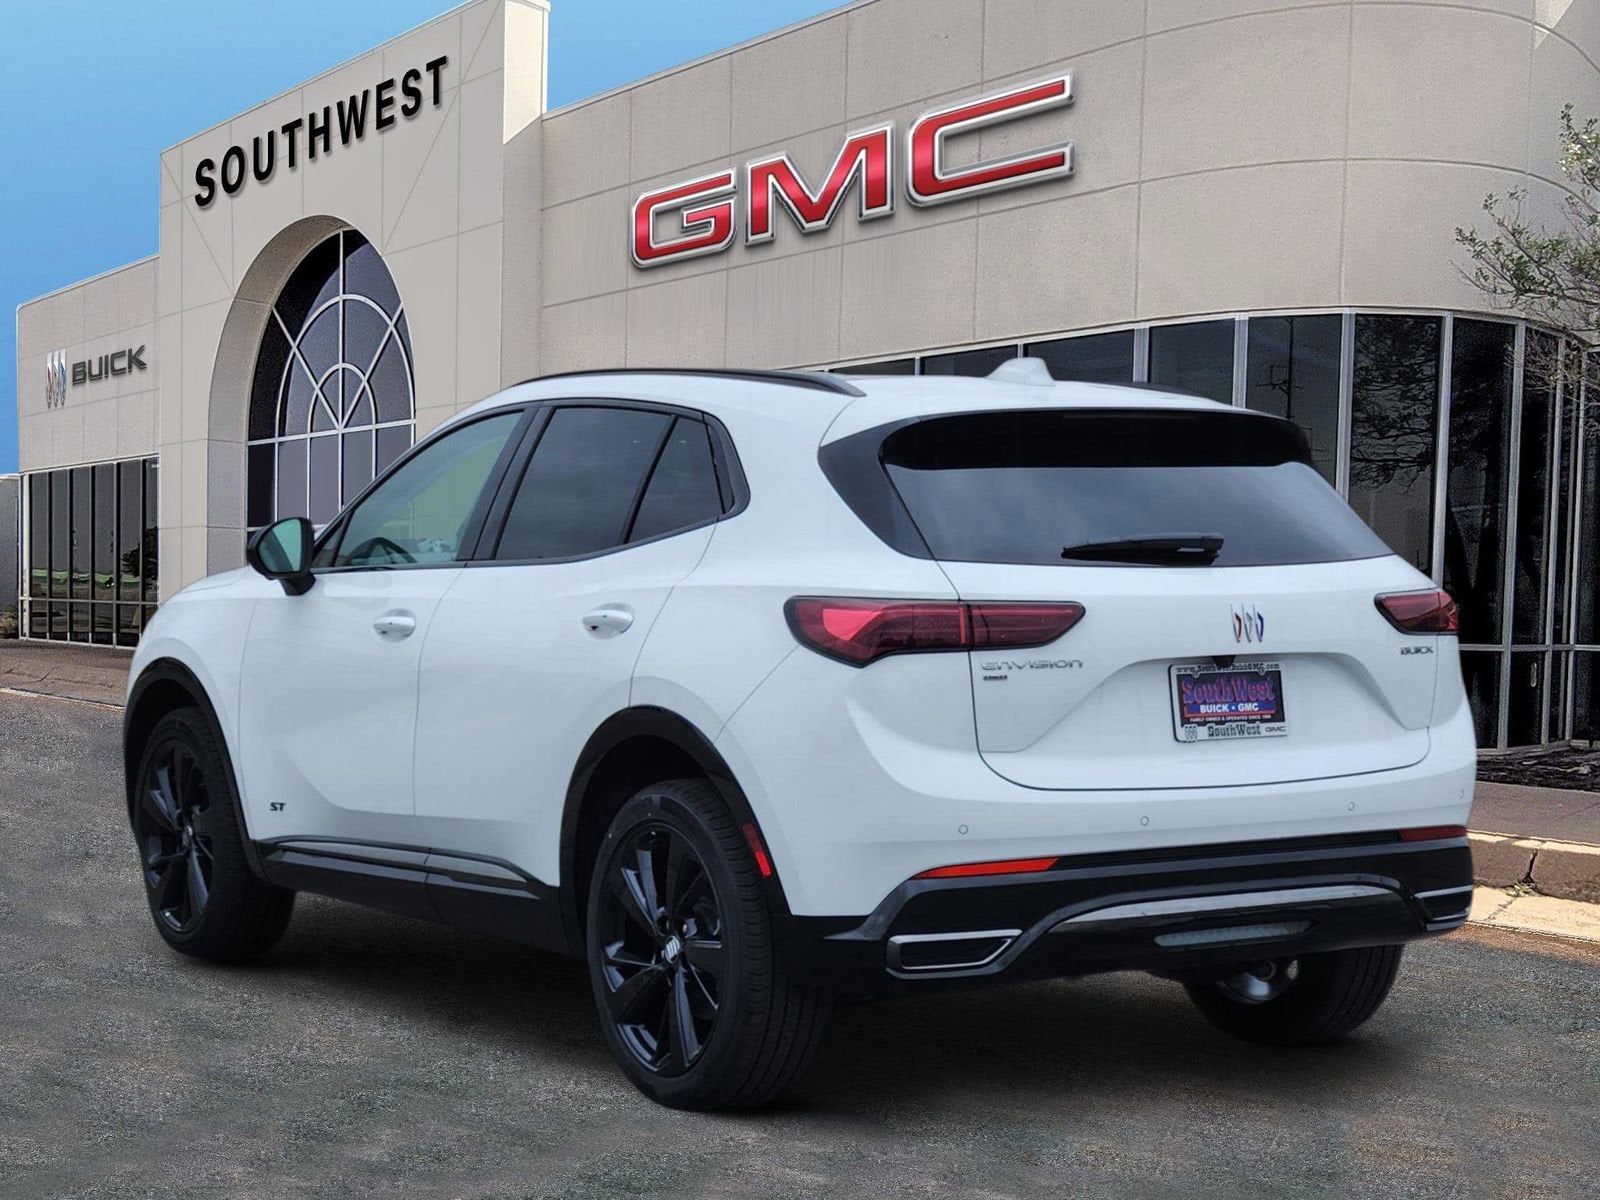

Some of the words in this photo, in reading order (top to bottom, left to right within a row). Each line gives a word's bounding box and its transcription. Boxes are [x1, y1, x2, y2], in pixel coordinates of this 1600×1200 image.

[194, 56, 448, 207] SOUTHWEST
[631, 70, 1074, 268] GMC
[72, 344, 147, 386] BUICK
[1400, 646, 1433, 655] BUICK
[1181, 677, 1275, 704] SouthWest
[1200, 704, 1229, 713] BUICK
[1237, 702, 1259, 712] GMC
[1208, 723, 1261, 737] SouthWest
[270, 802, 286, 811] ST
